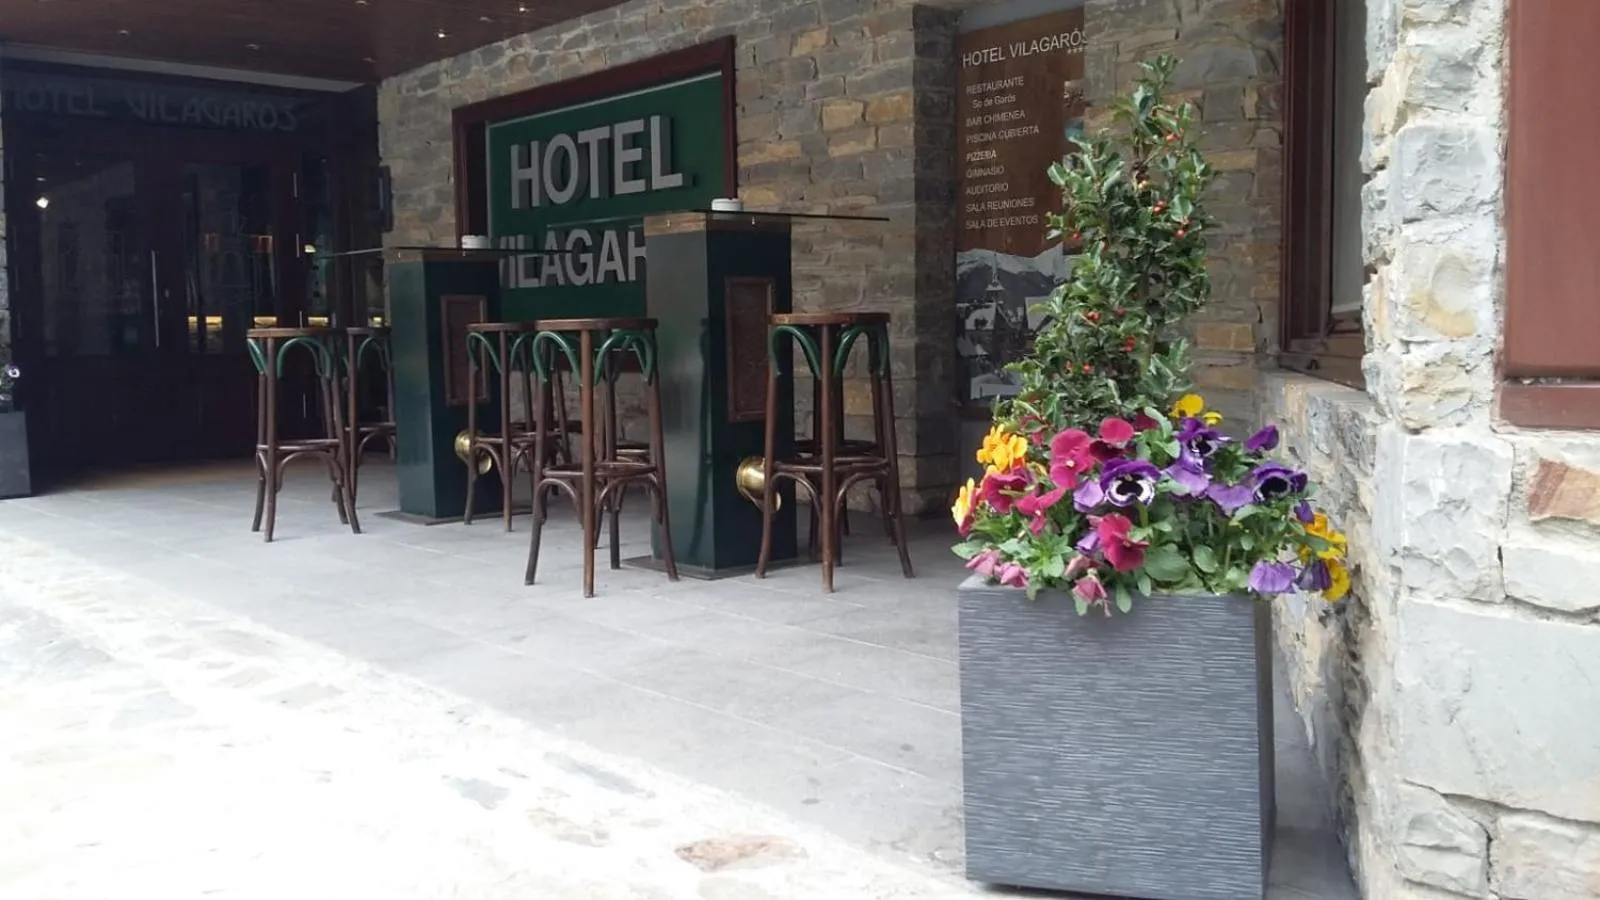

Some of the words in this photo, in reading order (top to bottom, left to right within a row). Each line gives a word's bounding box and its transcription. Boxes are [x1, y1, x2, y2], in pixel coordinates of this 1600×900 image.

[962, 47, 1006, 69] HOTEL
[966, 75, 1025, 95] RESTAURANTE
[3, 80, 106, 116] HOTEL
[965, 116, 982, 127] BAR
[983, 109, 1026, 124] CHIMENEA
[966, 131, 997, 145] PISCINA
[998, 124, 1040, 140] CUBIERTA
[510, 115, 685, 209] HOTEL
[965, 164, 1005, 179] GIMNASIO
[965, 182, 1009, 196] AUDITORIO
[965, 201, 986, 213] SALA
[987, 197, 1036, 210] REUNIONES
[965, 218, 986, 230] SALA
[987, 216, 999, 228] DE
[999, 214, 1039, 228] EVENTOS
